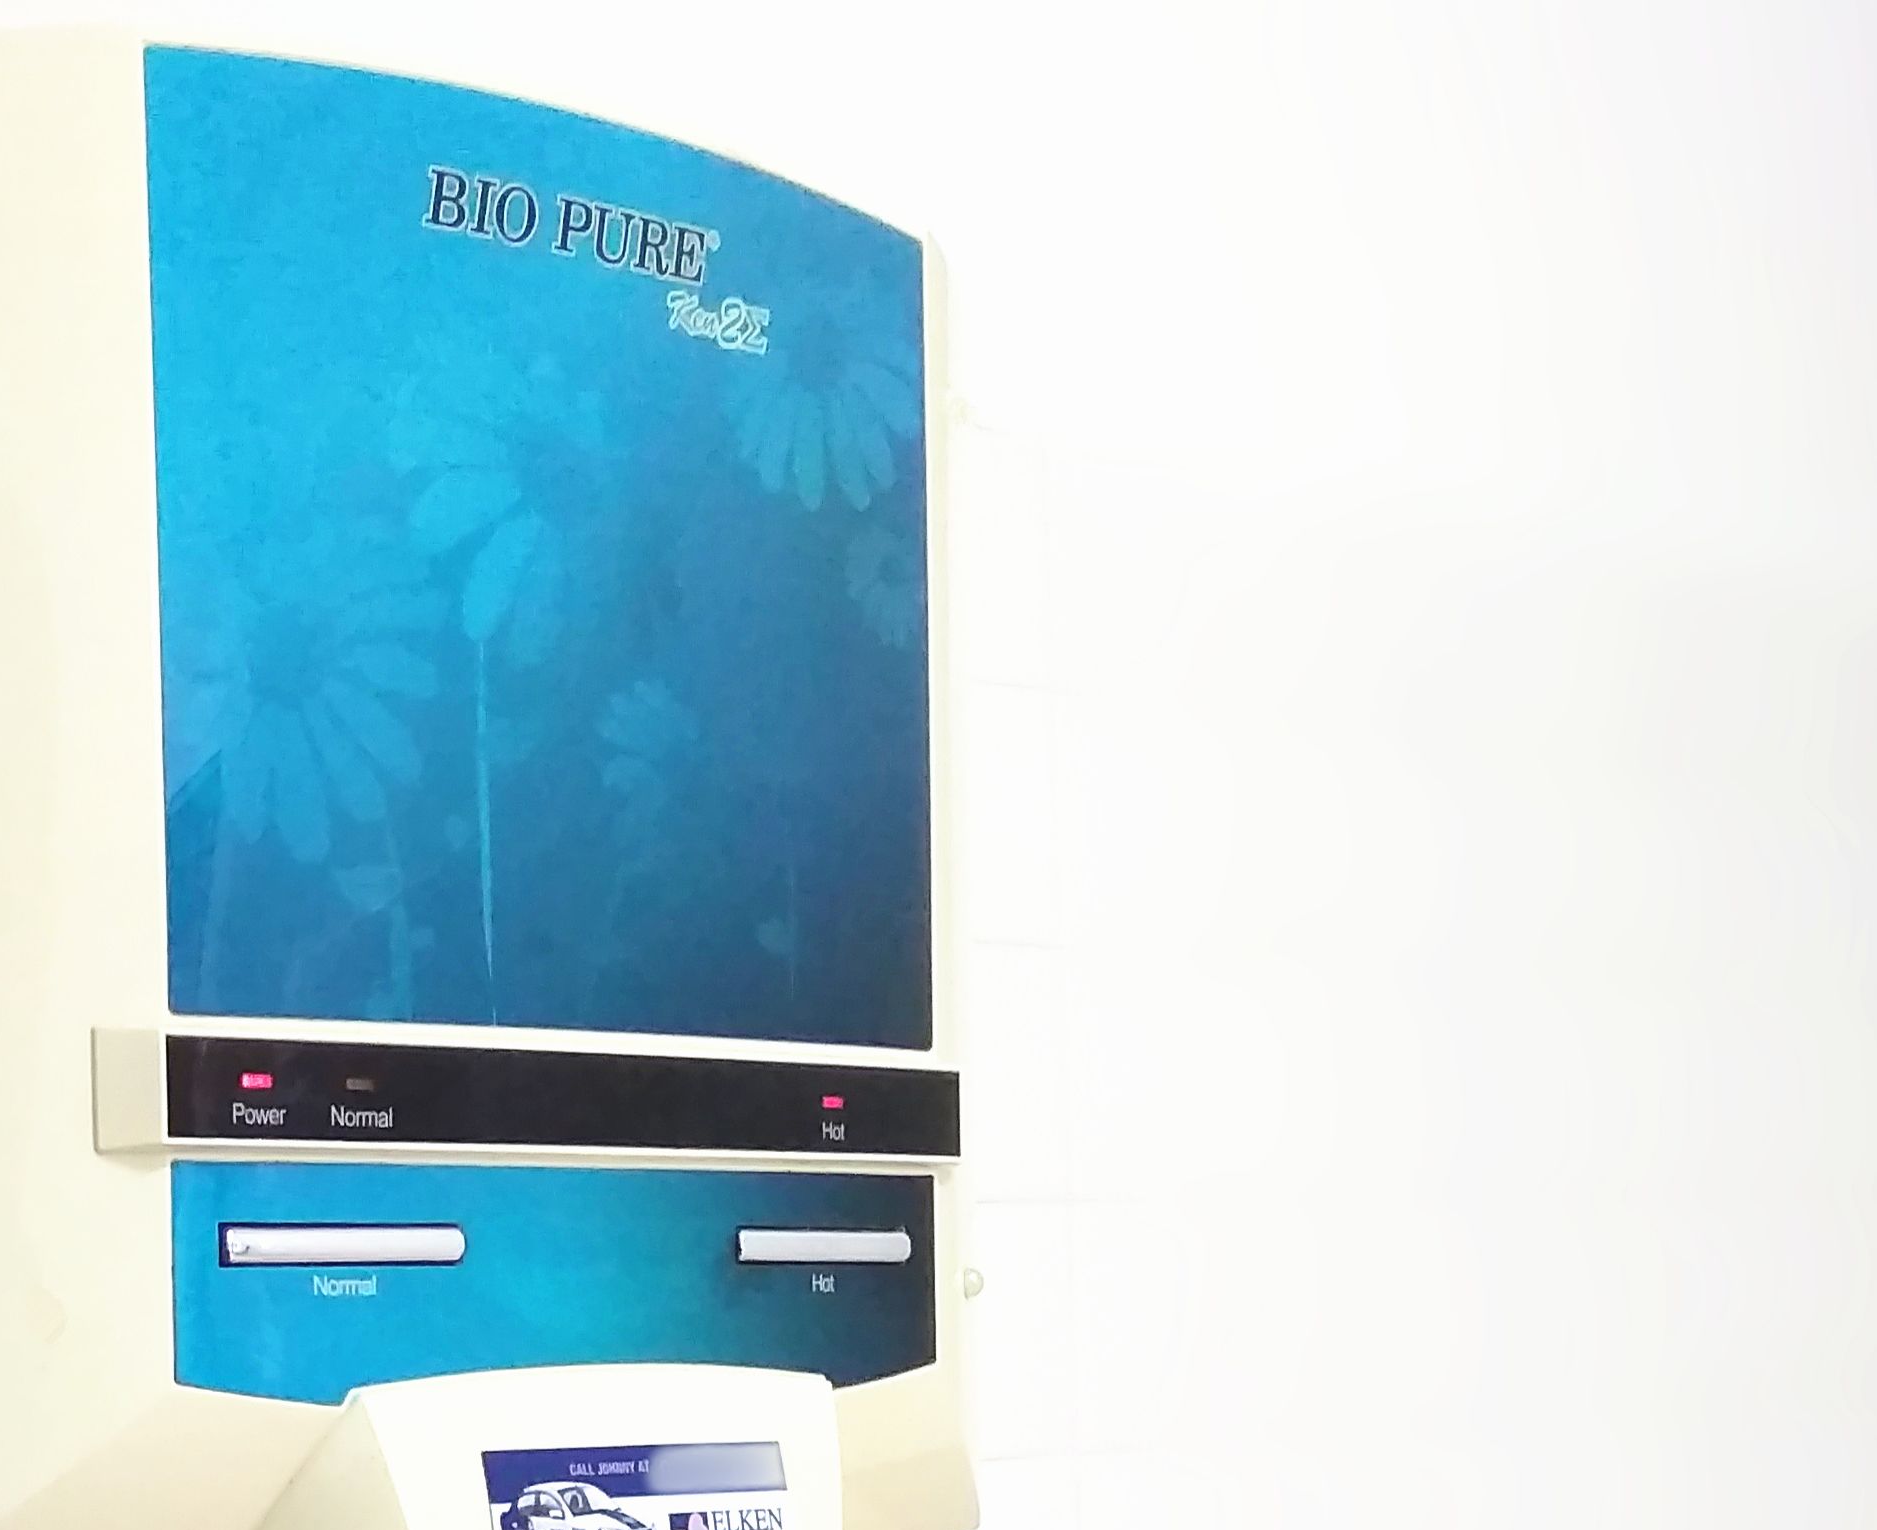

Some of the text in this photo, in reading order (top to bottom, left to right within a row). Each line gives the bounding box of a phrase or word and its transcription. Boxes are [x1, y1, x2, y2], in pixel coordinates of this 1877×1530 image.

[423, 164, 539, 248] BIO
[232, 1102, 394, 1129] Power Normal
[822, 1121, 845, 1141] Hot
[312, 1275, 377, 1297] Normal
[811, 1272, 835, 1293] Hot
[568, 1462, 596, 1476] CALL
